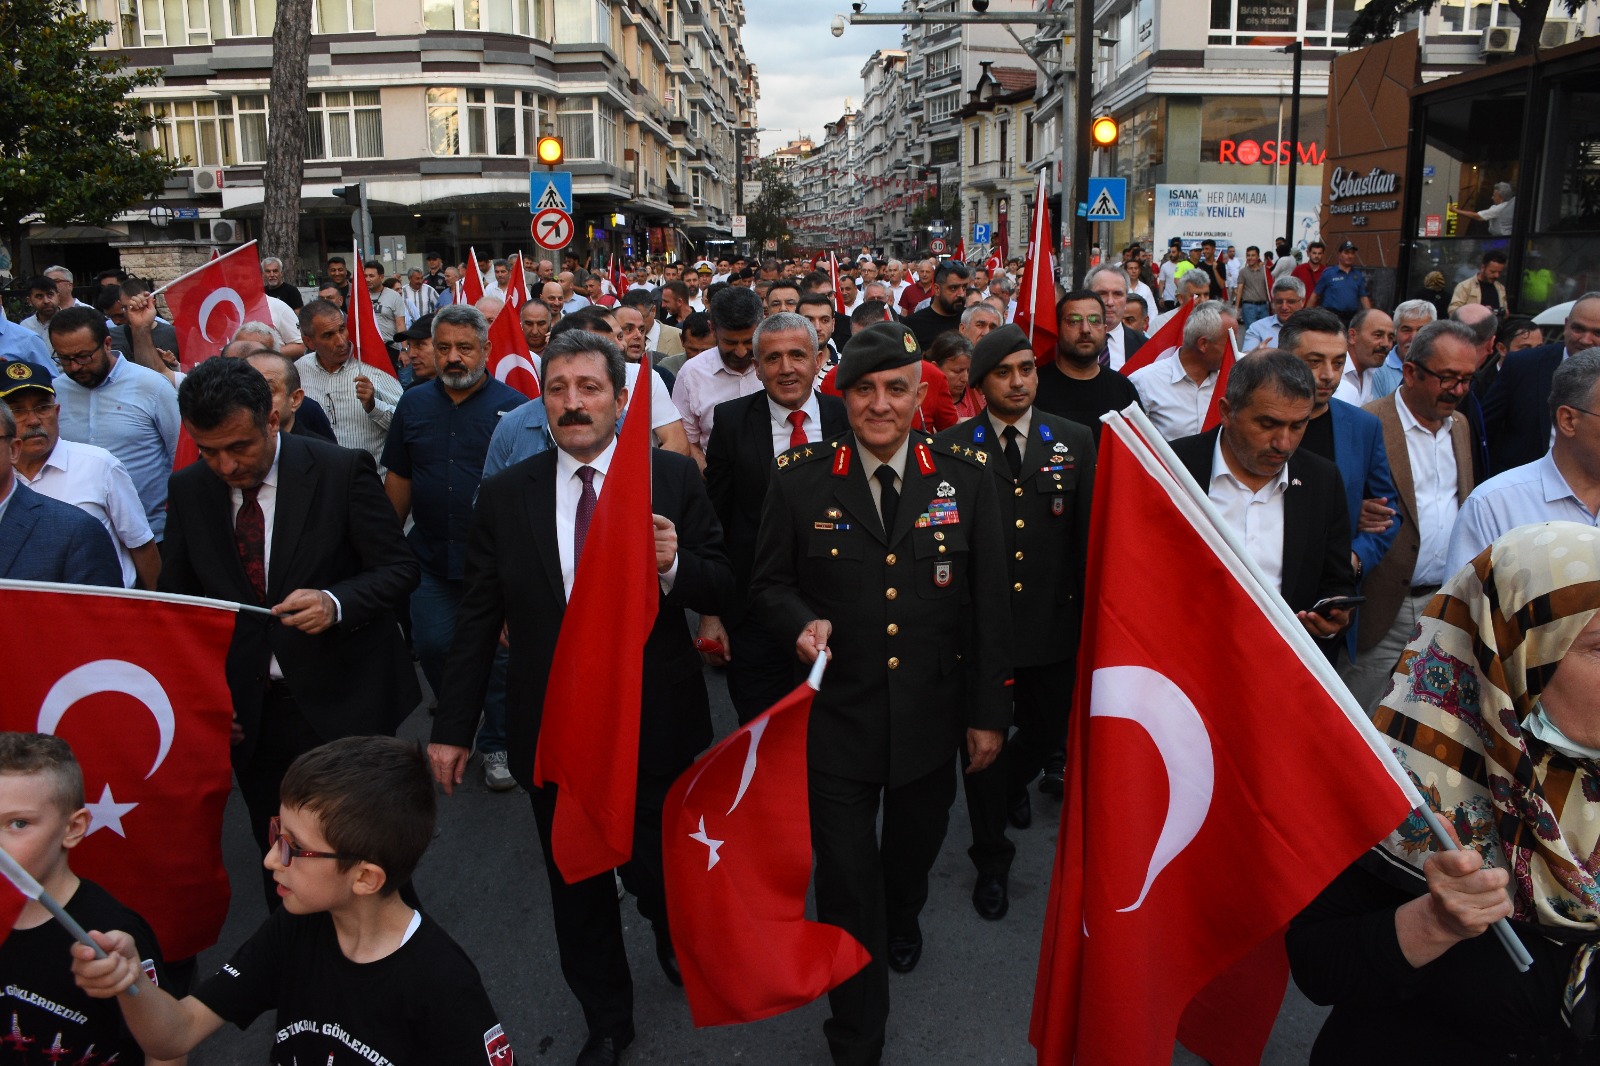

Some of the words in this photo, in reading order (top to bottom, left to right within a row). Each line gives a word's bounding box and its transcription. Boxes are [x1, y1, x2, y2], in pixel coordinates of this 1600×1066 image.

[1330, 166, 1396, 201] Sebastian
[1208, 192, 1224, 203] HER
[1226, 192, 1266, 204] DAMLADA
[1168, 208, 1198, 216] INTENSE
[1206, 204, 1244, 218] YENİLEN
[1362, 201, 1396, 211] RESTAURANT
[1352, 216, 1365, 224] CAFE
[976, 225, 986, 240] P
[6, 984, 88, 1024] GÖKLERDEDİR
